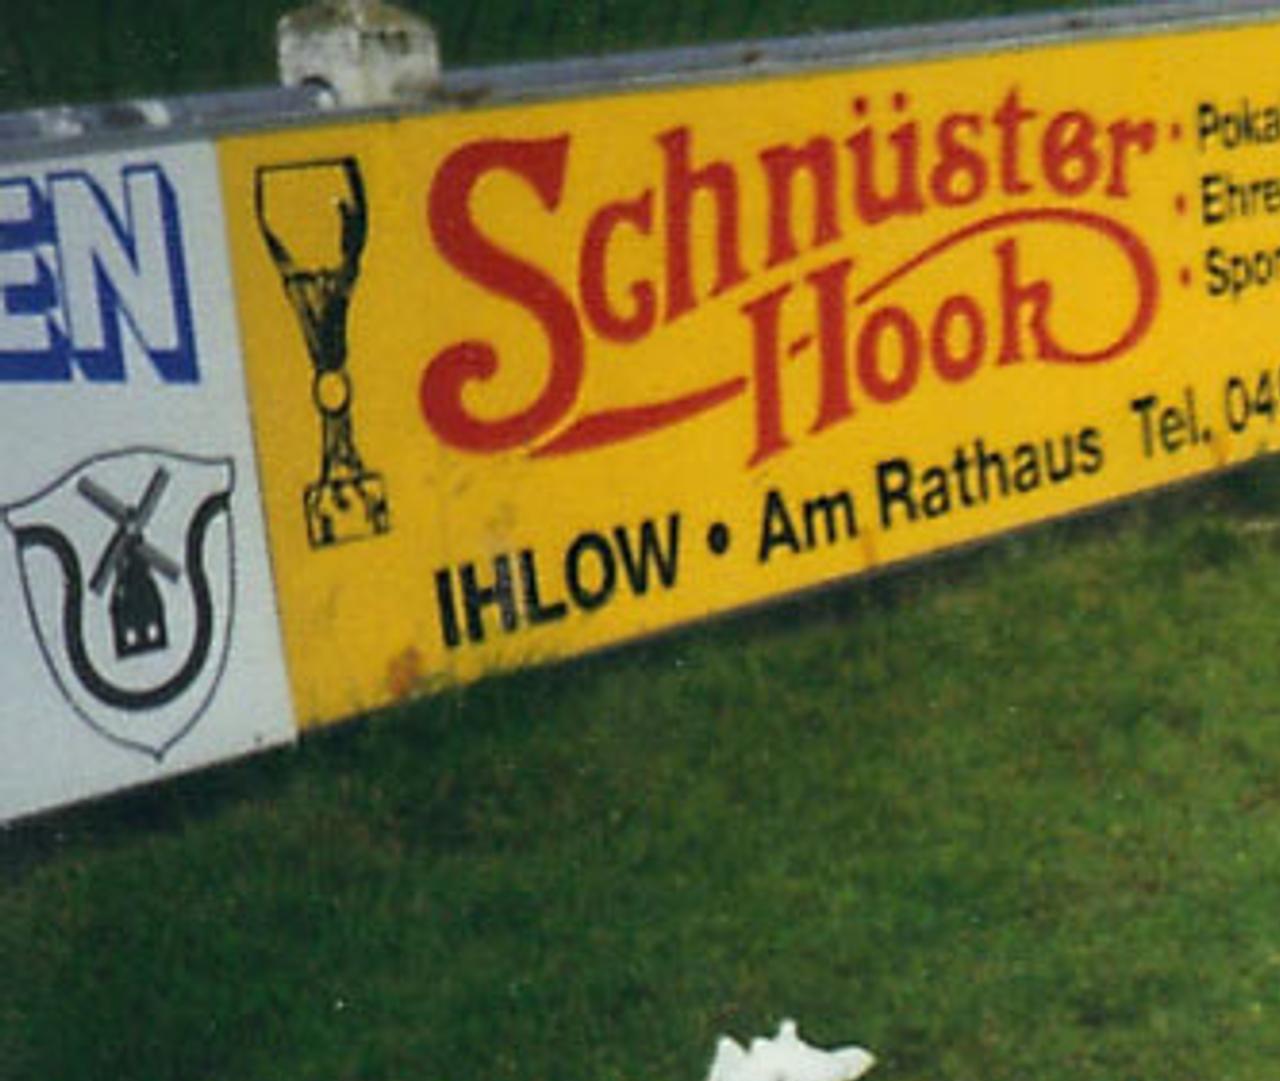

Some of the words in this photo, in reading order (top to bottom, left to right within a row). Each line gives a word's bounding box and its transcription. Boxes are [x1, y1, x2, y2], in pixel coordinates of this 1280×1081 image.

[0, 162, 200, 384] EN
[417, 83, 1155, 457] Schnüster
[433, 512, 682, 649] IHLOW
[757, 489, 858, 563] Am
[874, 426, 1104, 530] Rathaus
[1130, 386, 1212, 460] Tel.
